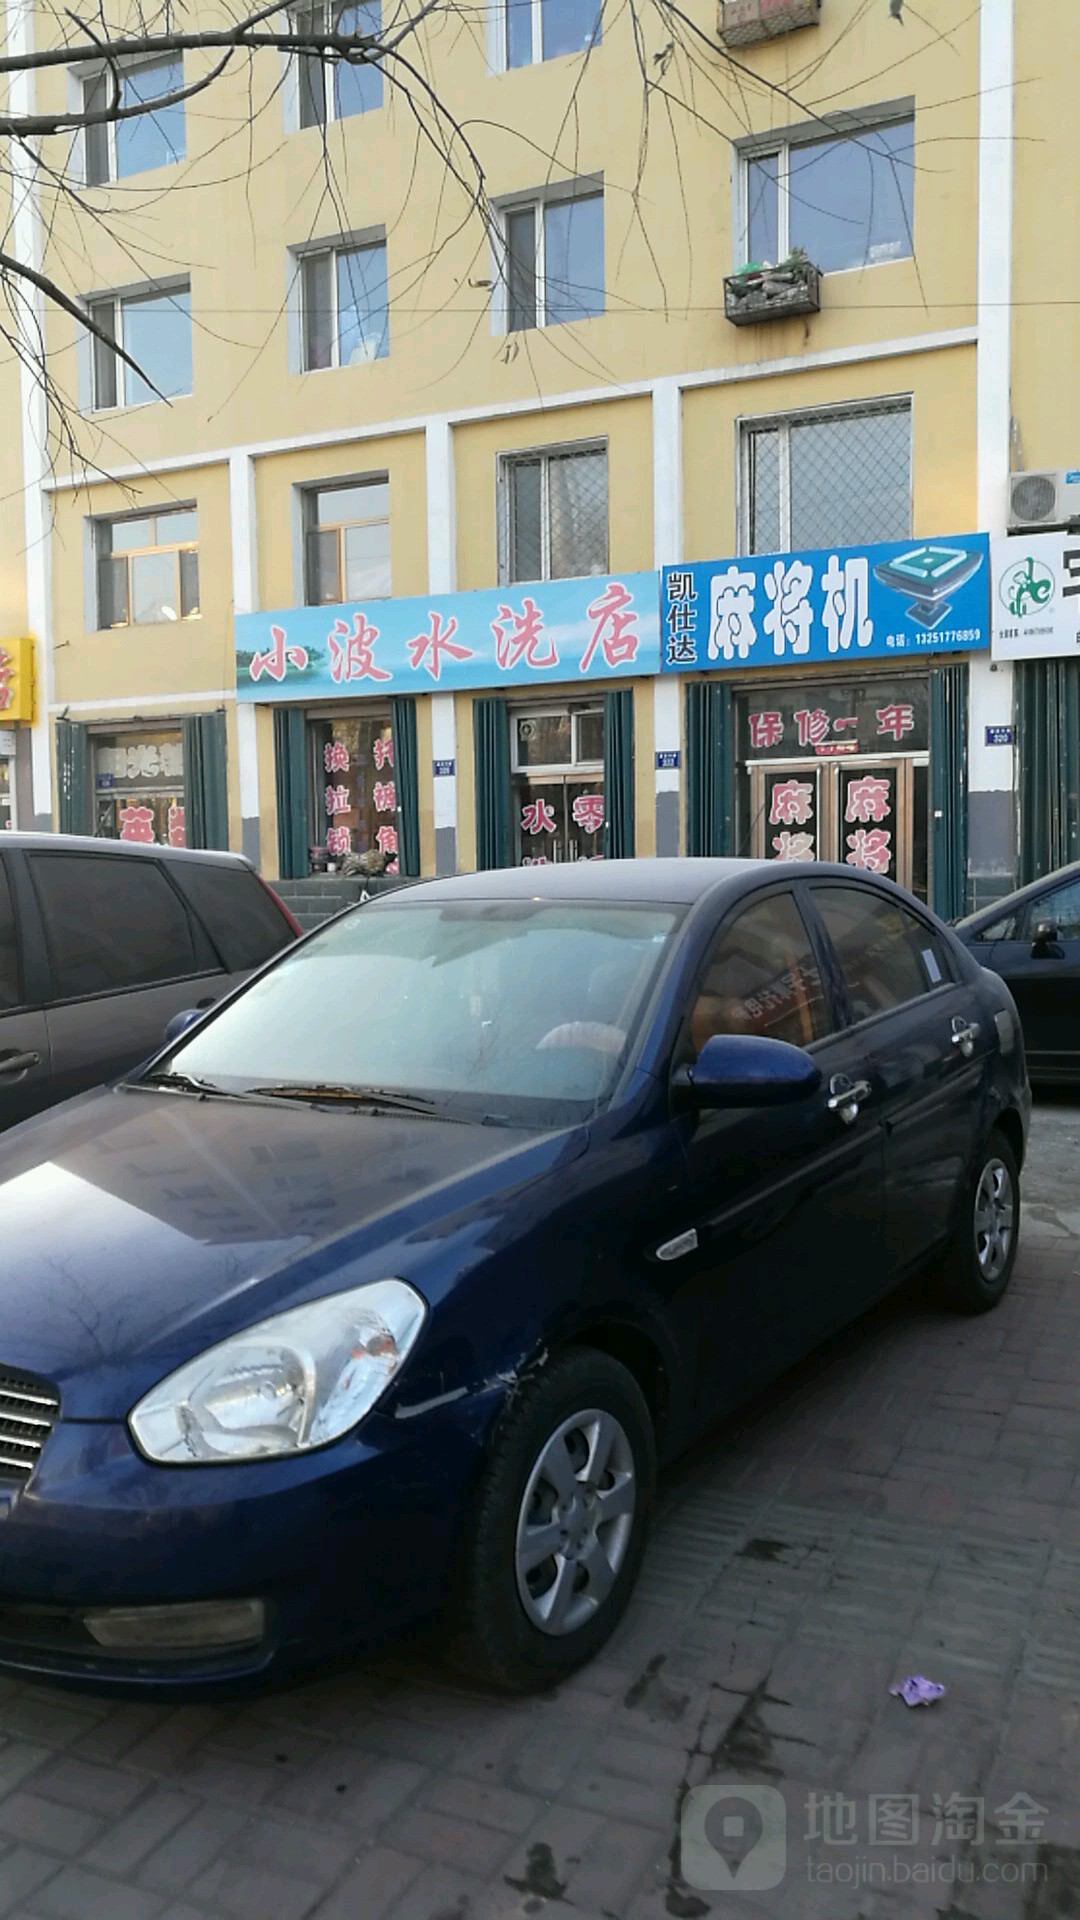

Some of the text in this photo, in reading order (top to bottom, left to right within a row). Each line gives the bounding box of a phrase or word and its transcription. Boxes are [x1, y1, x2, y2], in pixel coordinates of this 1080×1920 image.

[249, 582, 641, 683] 小波水洗店
[666, 571, 698, 665] 凯仕达
[707, 554, 874, 661] 麻将机
[748, 704, 914, 748] 保修一年
[324, 742, 351, 856] 换拉锁
[768, 779, 816, 863] 麻将
[844, 775, 892, 874] 麻将
